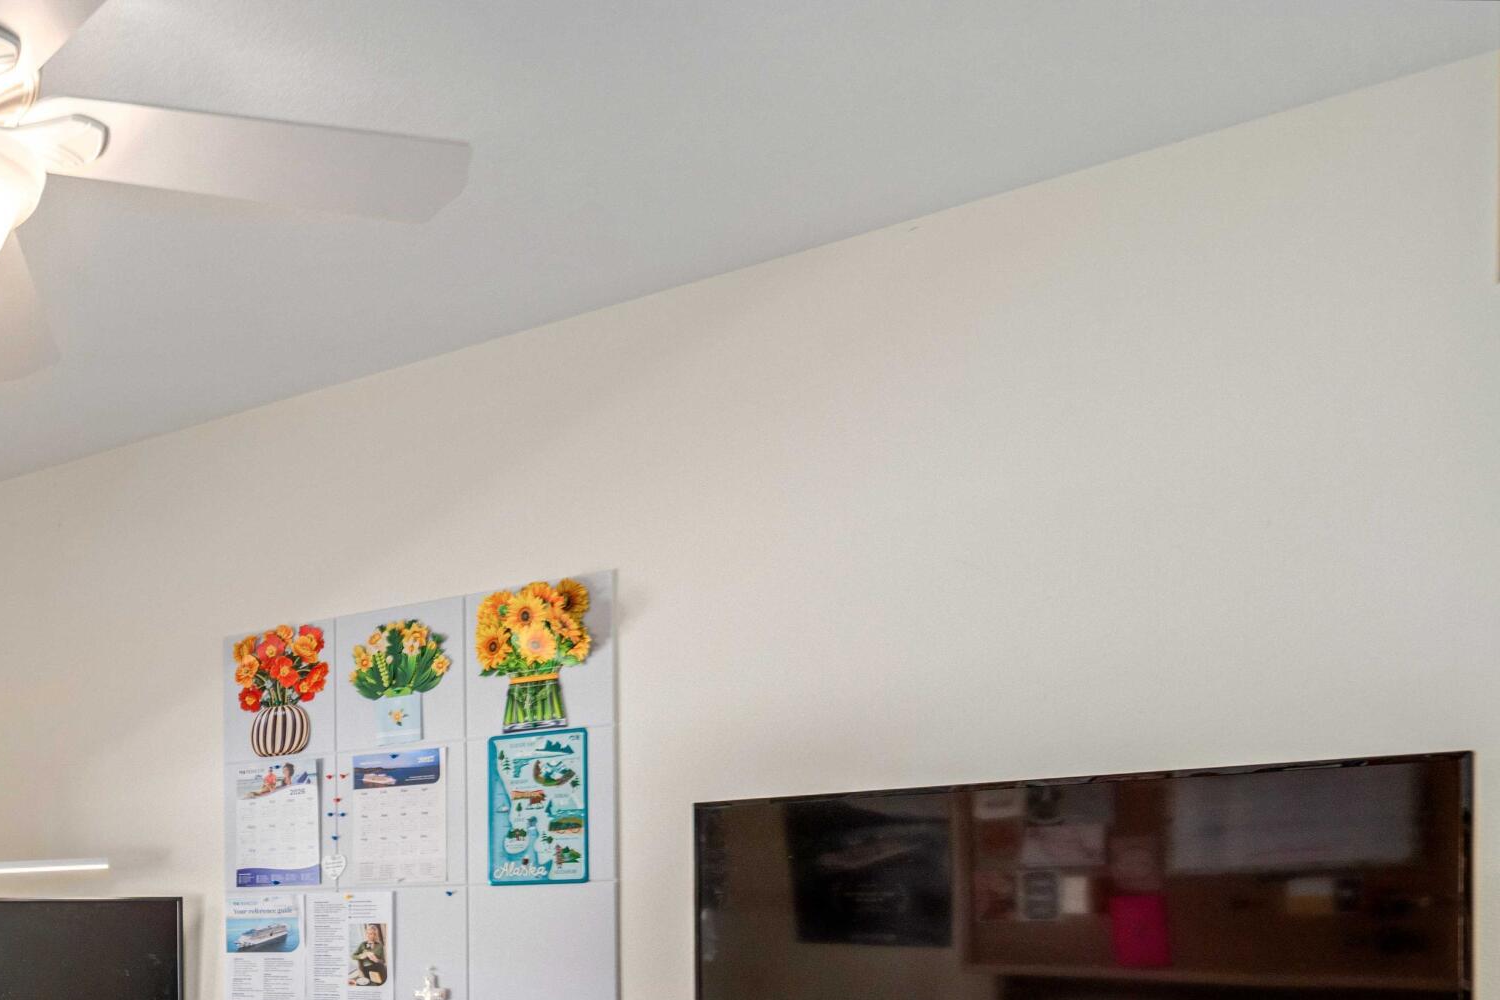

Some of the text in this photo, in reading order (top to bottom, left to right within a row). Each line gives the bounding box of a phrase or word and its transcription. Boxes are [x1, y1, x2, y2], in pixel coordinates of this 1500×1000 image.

[493, 862, 548, 880] Alaska
[248, 906, 276, 914] reference
[277, 905, 293, 914] guide
